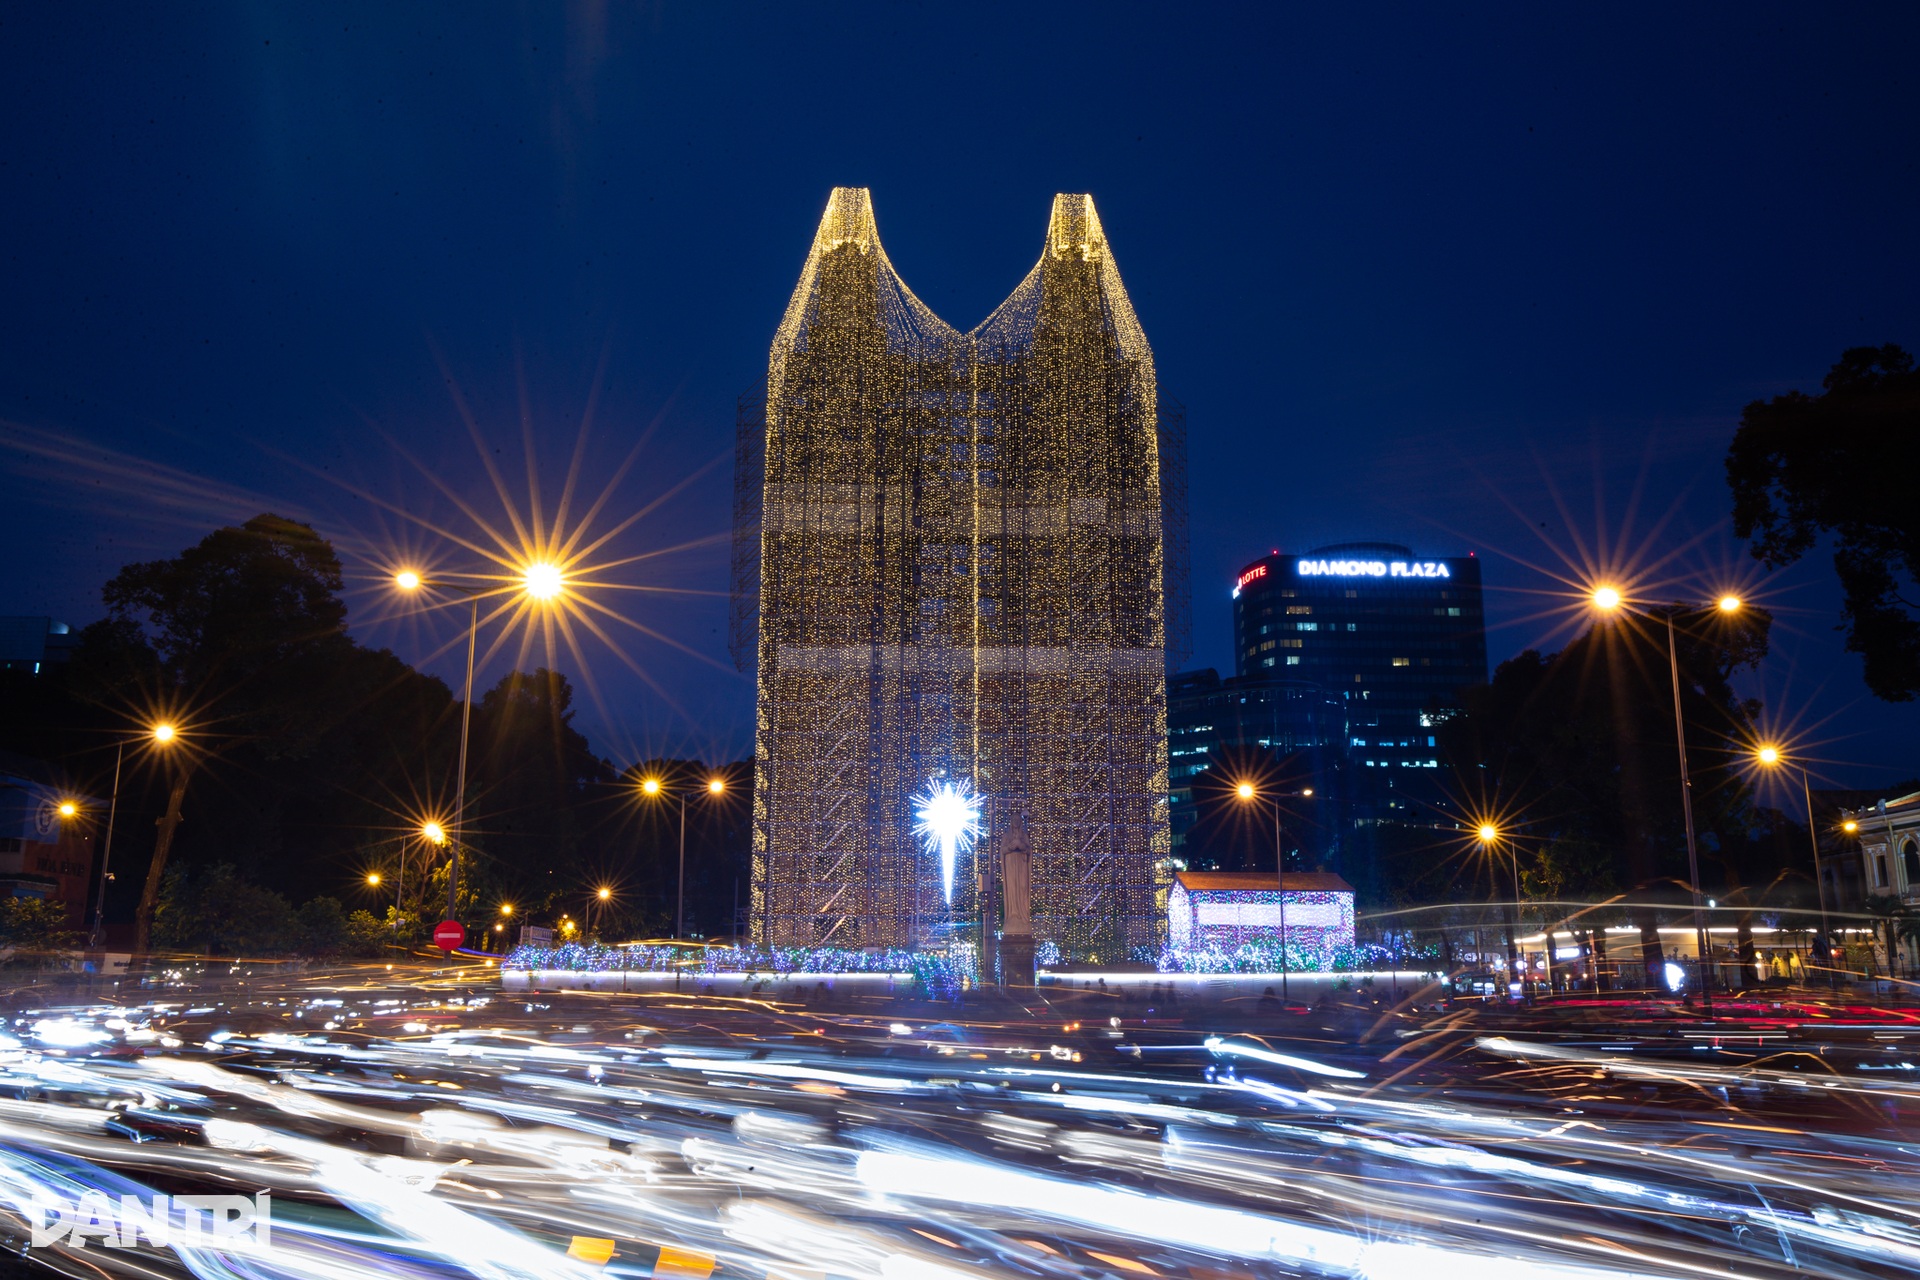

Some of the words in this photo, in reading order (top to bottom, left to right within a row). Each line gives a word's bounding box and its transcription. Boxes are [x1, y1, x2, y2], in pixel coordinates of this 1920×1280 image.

[1242, 565, 1266, 585] LOTTE
[1298, 560, 1387, 577] DIAMOND
[1391, 561, 1450, 578] PLAZA
